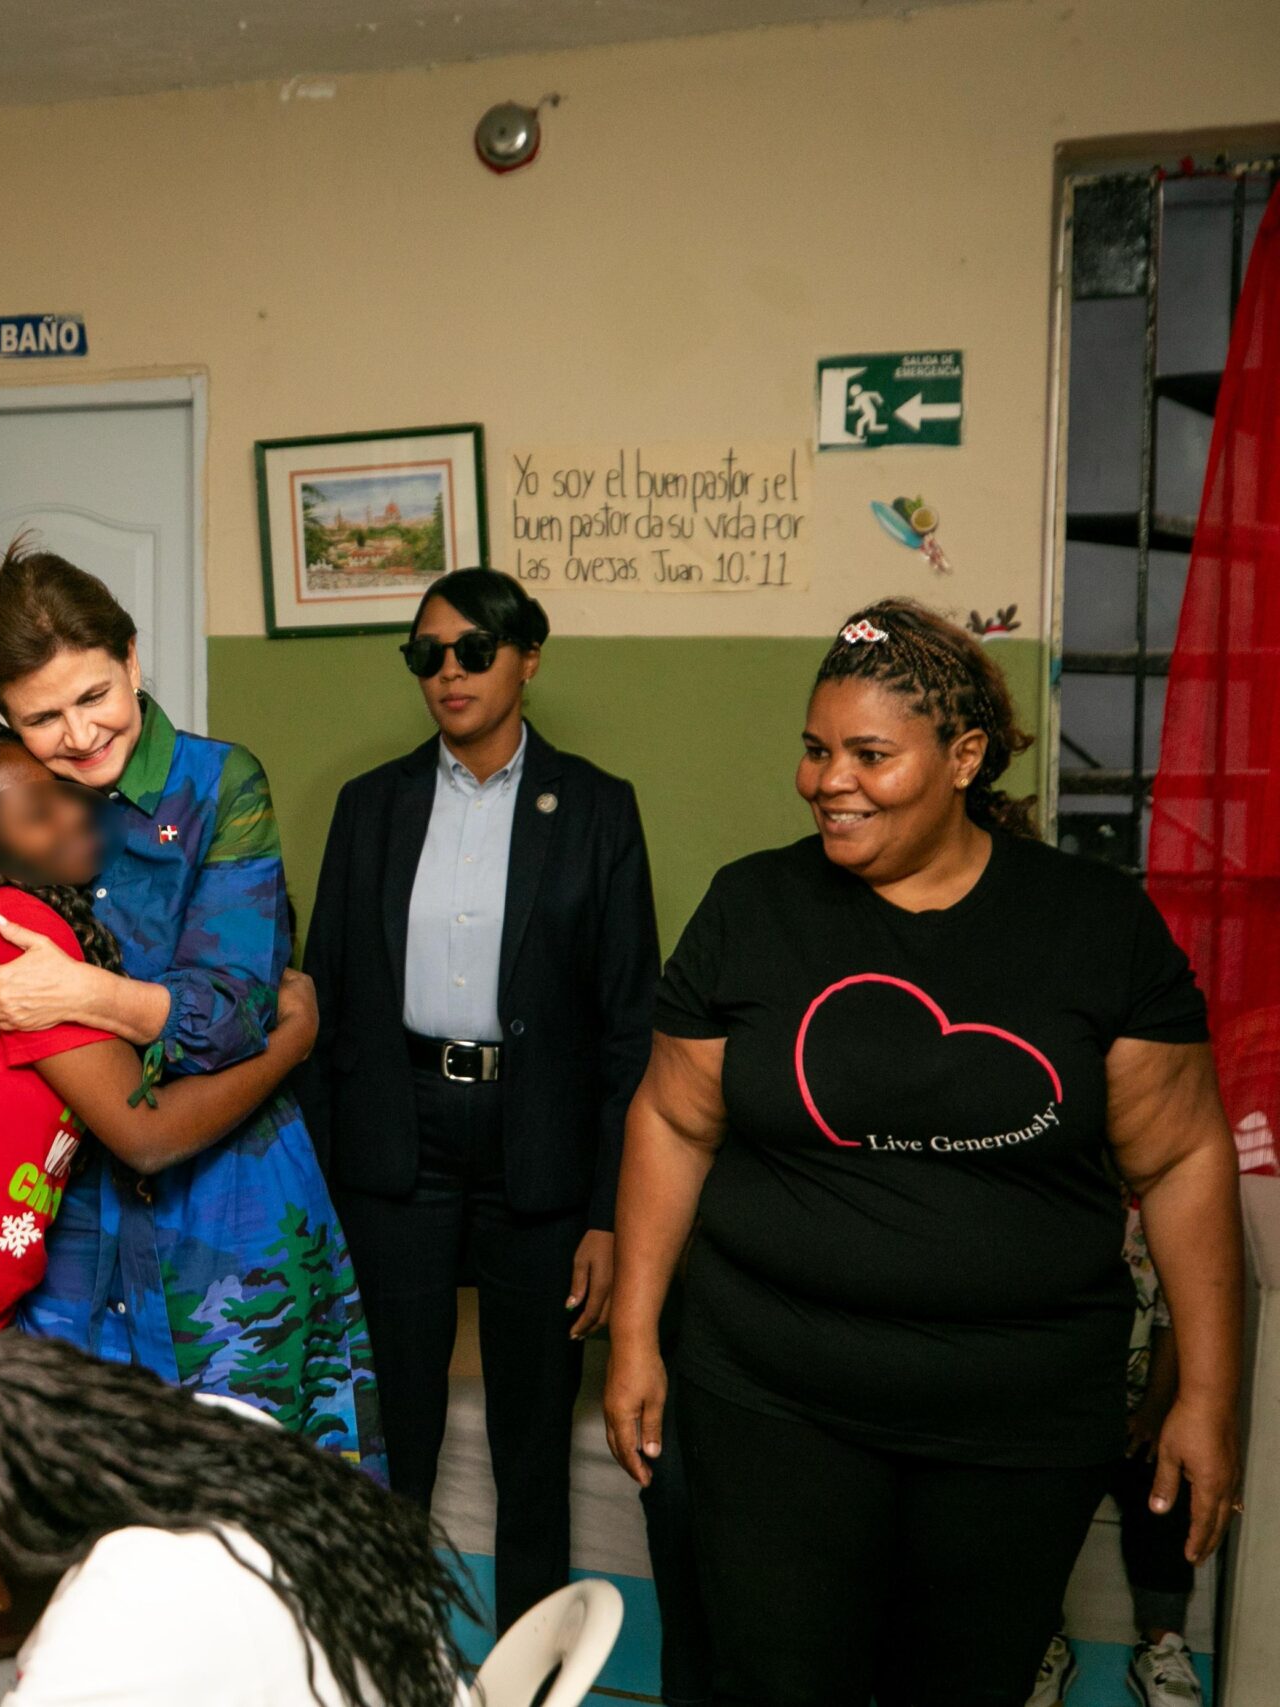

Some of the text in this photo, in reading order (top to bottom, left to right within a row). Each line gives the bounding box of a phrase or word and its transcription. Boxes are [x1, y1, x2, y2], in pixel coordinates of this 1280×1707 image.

[0, 315, 80, 352] BAÑO
[894, 365, 961, 378] EMERGENCIA
[902, 354, 955, 366] SALIDA DE
[513, 453, 539, 496] Yo
[553, 469, 595, 498] soy
[606, 448, 626, 498] el
[513, 498, 562, 542] buen
[570, 502, 631, 556] pastor
[703, 500, 756, 540] vida
[651, 549, 703, 583] Juan
[866, 1134, 923, 1151] Live
